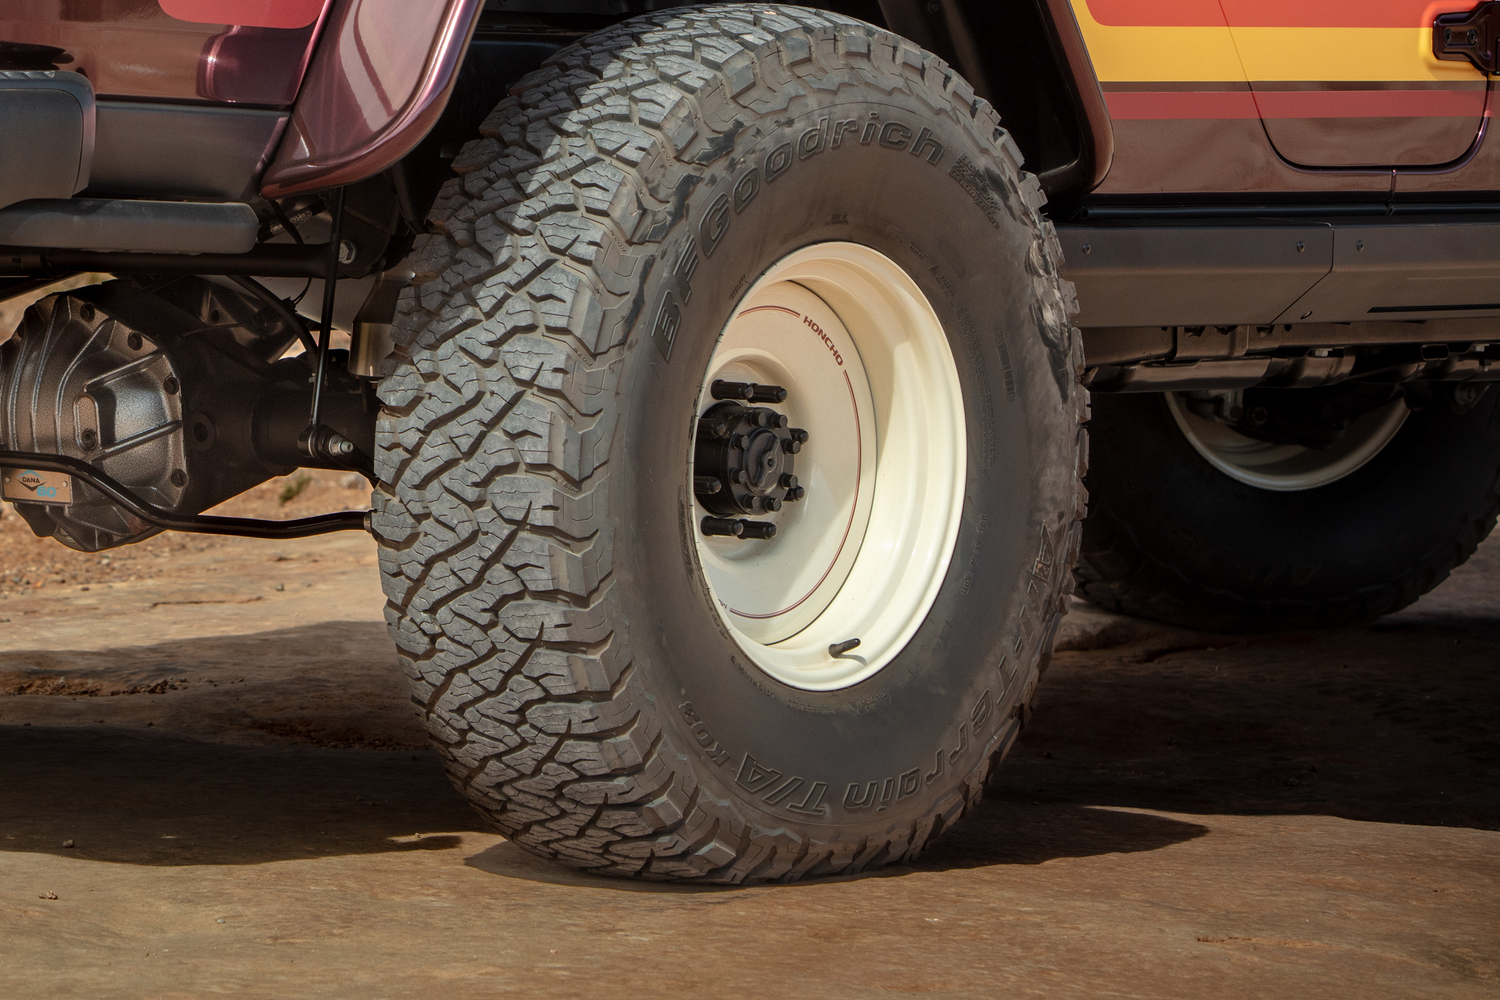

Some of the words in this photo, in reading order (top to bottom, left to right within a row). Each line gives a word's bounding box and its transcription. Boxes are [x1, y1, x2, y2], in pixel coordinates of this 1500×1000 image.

[651, 111, 946, 363] BFGoodrich
[803, 315, 844, 367] HONCHO
[22, 476, 41, 484] DANA
[36, 485, 57, 498] 60
[842, 519, 1054, 813] All-Terrain
[678, 701, 731, 768] KO3
[734, 752, 829, 816] T/A
